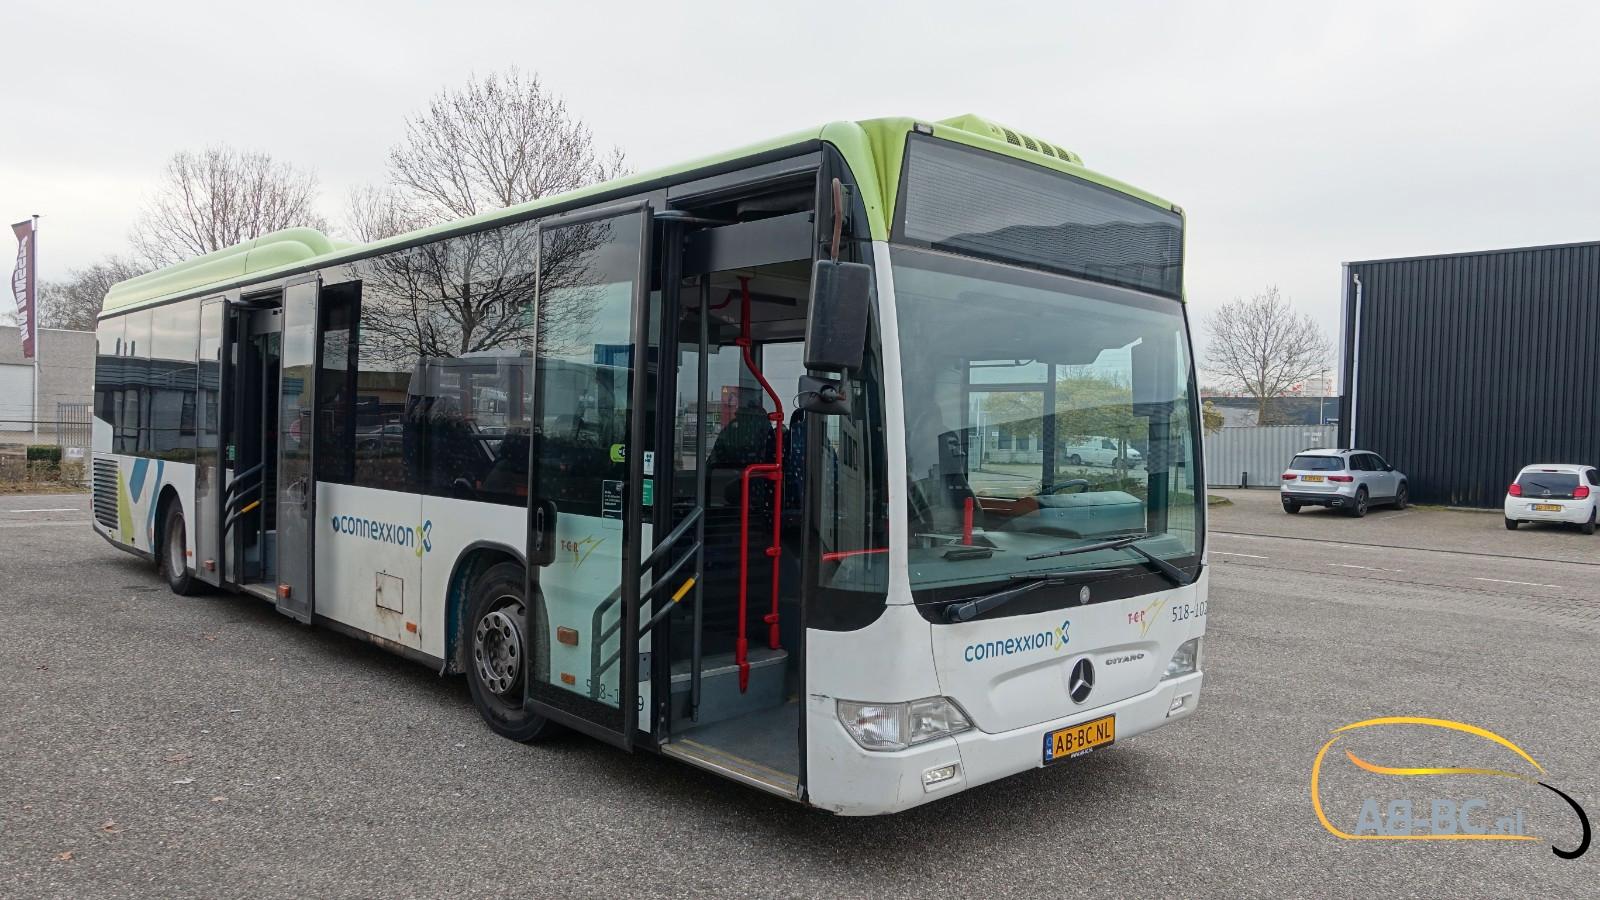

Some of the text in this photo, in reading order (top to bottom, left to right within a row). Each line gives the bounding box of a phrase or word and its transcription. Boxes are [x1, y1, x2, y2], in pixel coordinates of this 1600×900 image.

[341, 515, 414, 548] connexxion
[965, 631, 1053, 662] connexxion
[1105, 653, 1145, 666] CITARO
